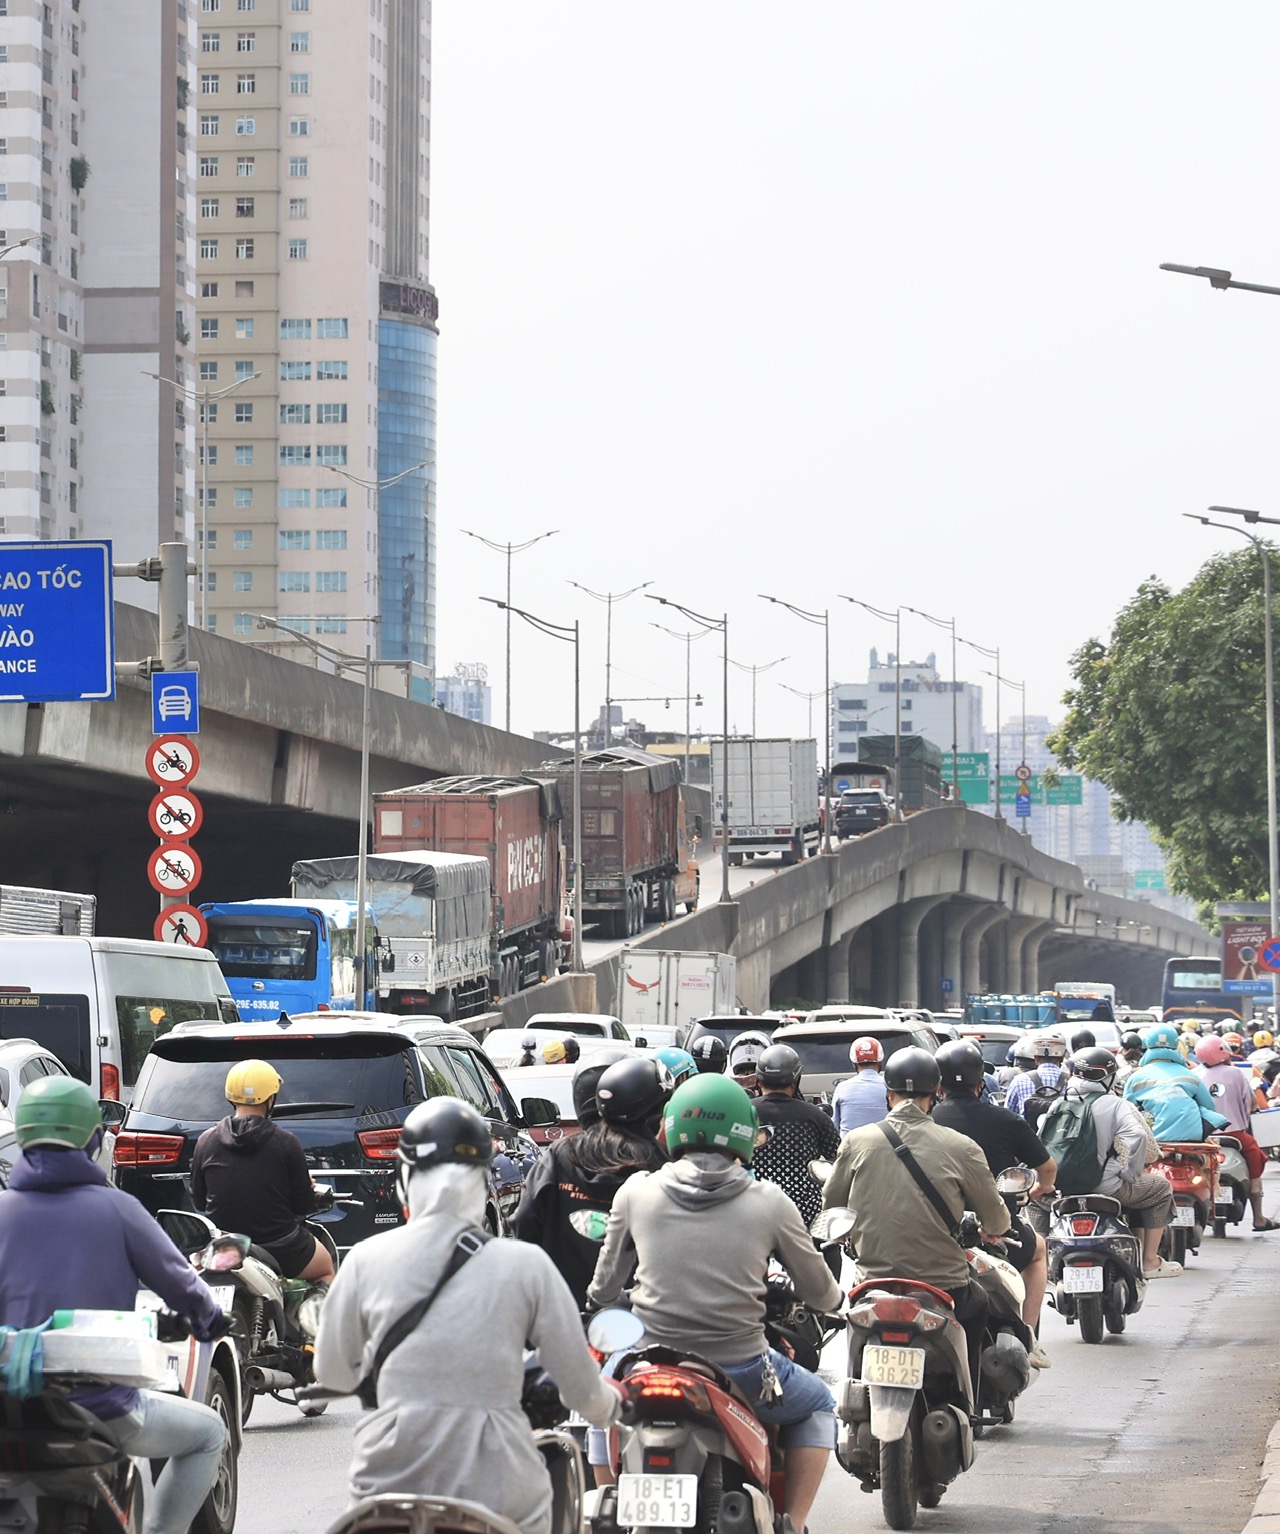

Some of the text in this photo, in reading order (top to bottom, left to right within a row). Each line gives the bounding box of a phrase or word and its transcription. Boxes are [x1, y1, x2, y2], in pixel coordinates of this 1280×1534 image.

[37, 564, 83, 589] TỐC
[8, 997, 21, 1006] HỢP
[558, 1182, 573, 1192] THE
[1069, 1268, 1097, 1280] 29-AC
[1067, 1280, 1100, 1292] 813.76
[874, 1349, 915, 1366] 18-D1
[633, 1479, 684, 1499] 18-E1
[623, 1502, 691, 1523] 489.13
